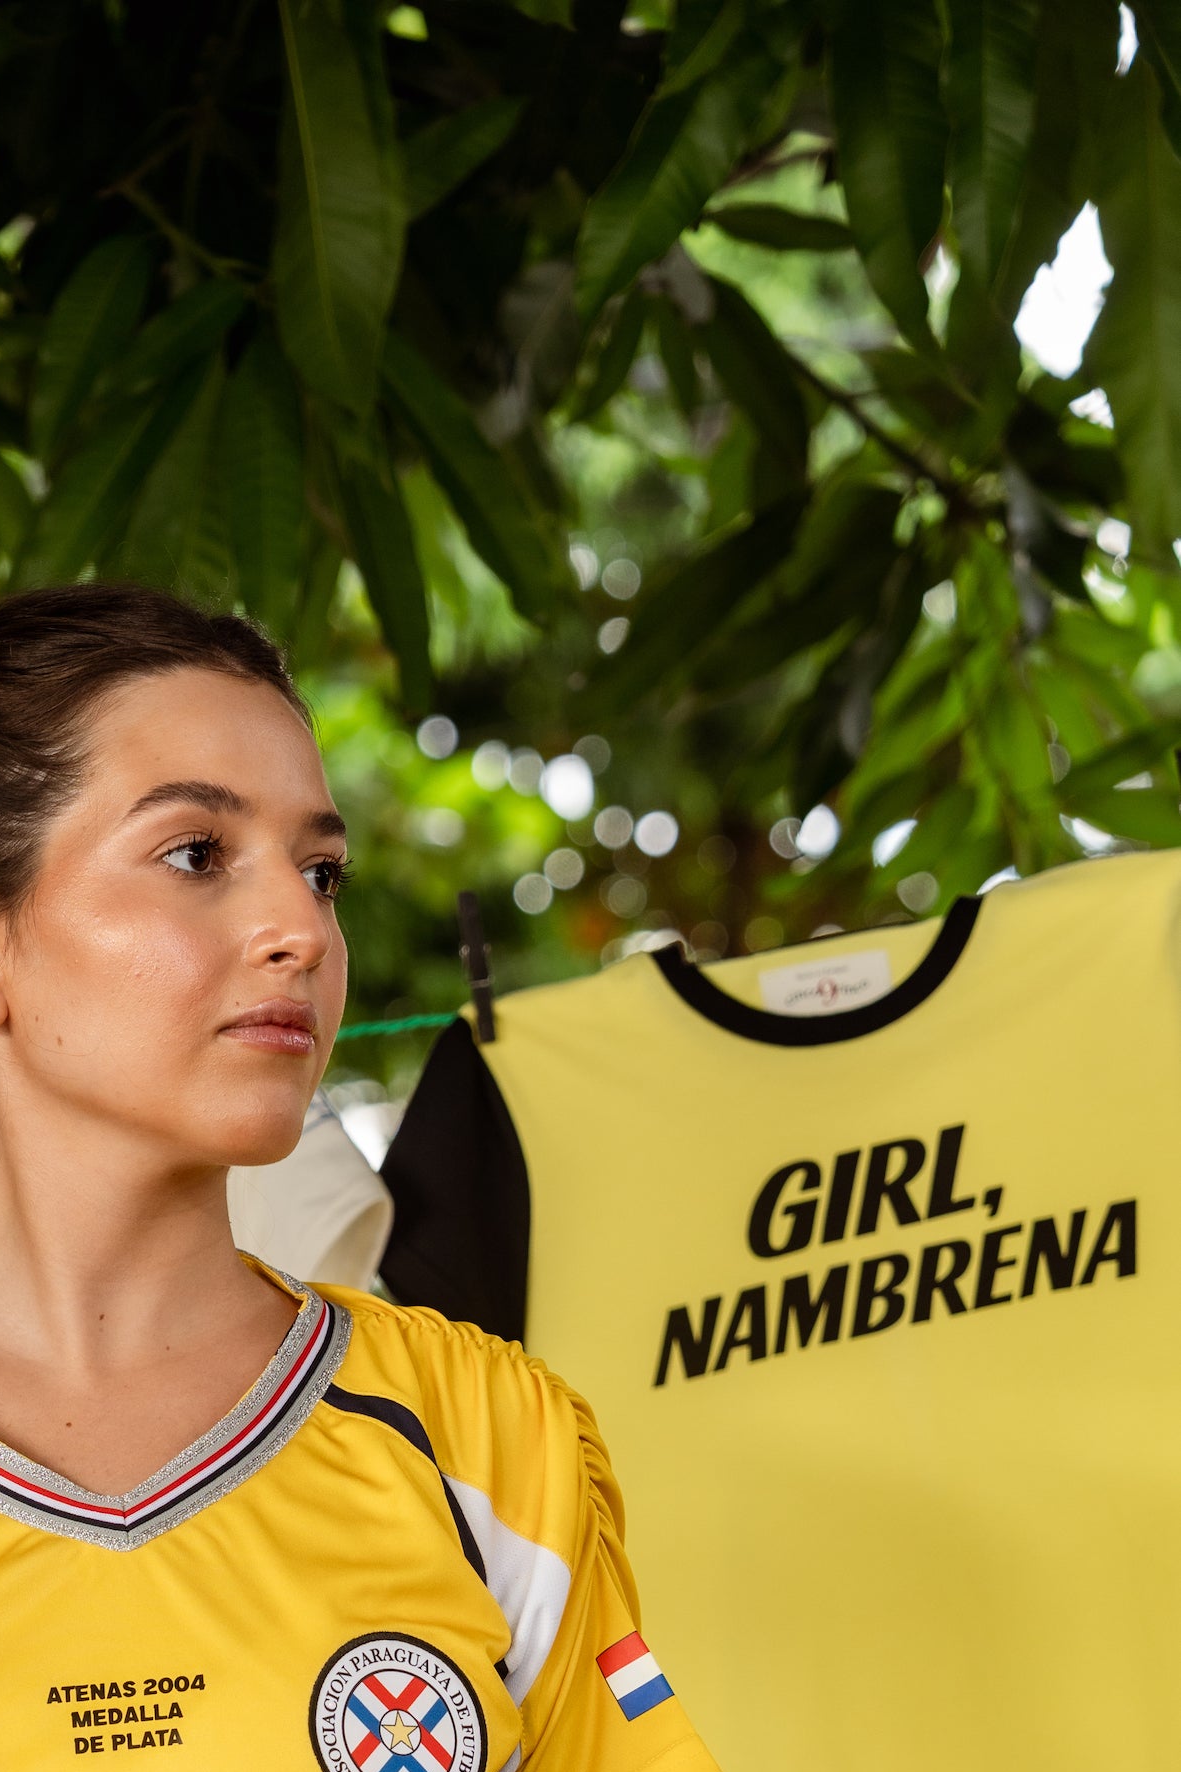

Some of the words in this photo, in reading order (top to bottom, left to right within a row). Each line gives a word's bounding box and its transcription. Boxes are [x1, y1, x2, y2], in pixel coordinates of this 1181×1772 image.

[747, 1122, 1003, 1258] GIRL,
[652, 1198, 1137, 1388] NAMBRENA
[47, 1681, 136, 1704] ATENAS
[143, 1674, 206, 1696] 2004
[349, 1647, 451, 1692] PARAGUAYA
[449, 1690, 470, 1720] DE
[71, 1702, 183, 1728] MEDALLA
[74, 1735, 105, 1754] DE
[112, 1728, 183, 1751] PLATA
